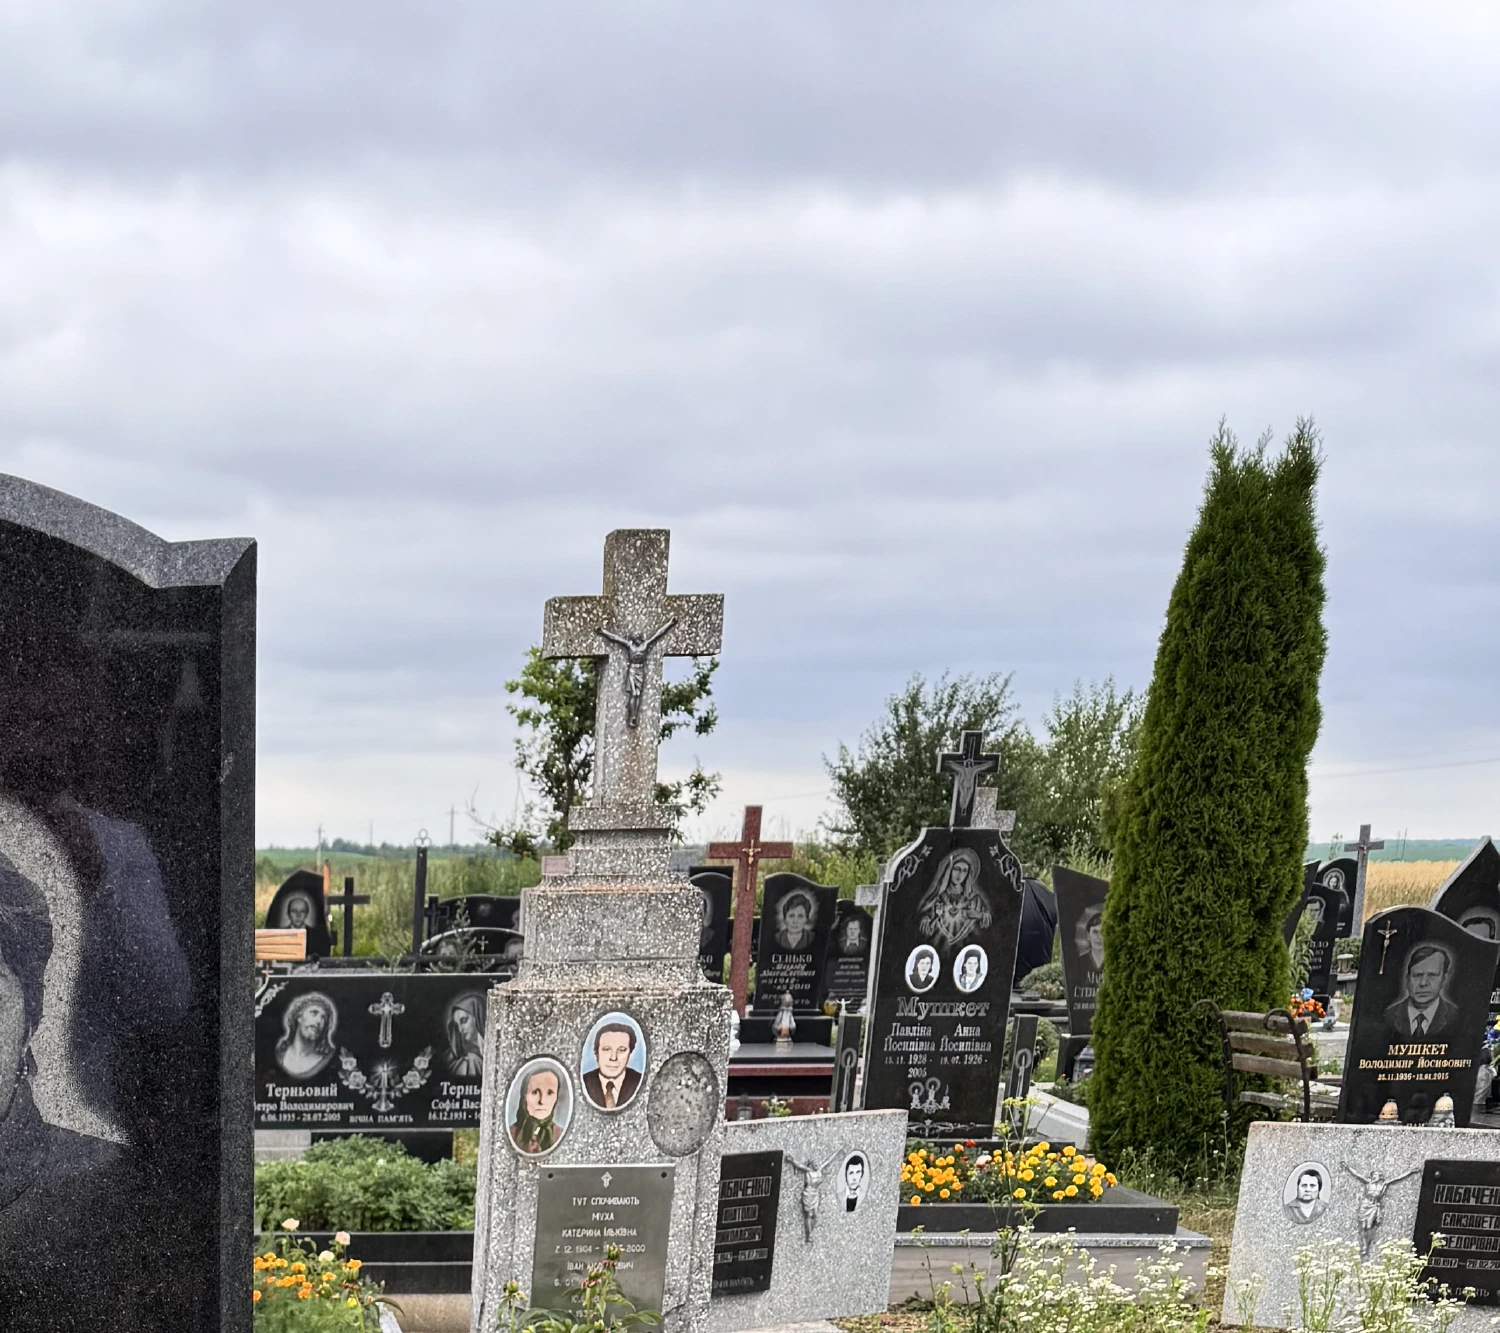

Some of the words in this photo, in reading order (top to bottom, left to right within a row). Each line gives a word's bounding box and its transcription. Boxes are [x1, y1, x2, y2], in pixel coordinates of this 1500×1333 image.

[895, 996, 990, 1020] Мушкет
[891, 1022, 932, 1037] Павліна
[954, 1022, 981, 1037] Анна
[883, 1035, 936, 1051] Йосипівна
[939, 1035, 992, 1051] Йосипівна
[1388, 1044, 1448, 1055] МУШКЕТ
[265, 1082, 338, 1100] Терньовий
[440, 1081, 481, 1099] Тернь
[279, 1100, 355, 1112] Володимирович
[431, 1098, 460, 1111] Софія
[462, 1098, 481, 1110] Вас
[719, 1176, 772, 1200] АБАЧЕНКО
[572, 1197, 587, 1206] ТУТ
[591, 1212, 615, 1221] МУХА
[561, 1228, 602, 1238] КАТЕРИНА
[1436, 1234, 1499, 1252] ЕДОРІВНА
[567, 1261, 584, 1270] ІВАН
